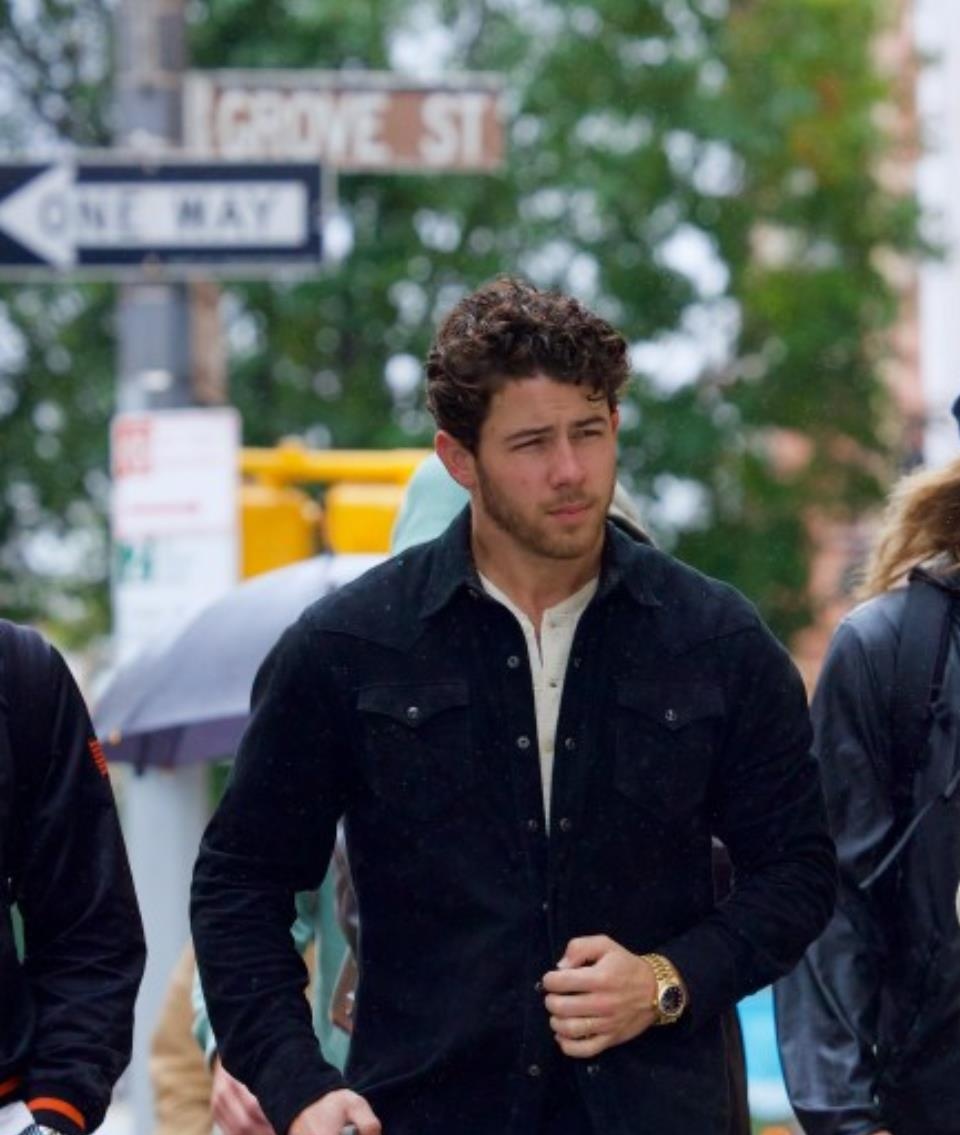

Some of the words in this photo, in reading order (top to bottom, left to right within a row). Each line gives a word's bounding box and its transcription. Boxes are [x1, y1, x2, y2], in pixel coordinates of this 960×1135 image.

[213, 88, 391, 163] GROVE
[420, 90, 487, 163] ST
[38, 190, 140, 233] ONE
[175, 190, 277, 232] WAY
